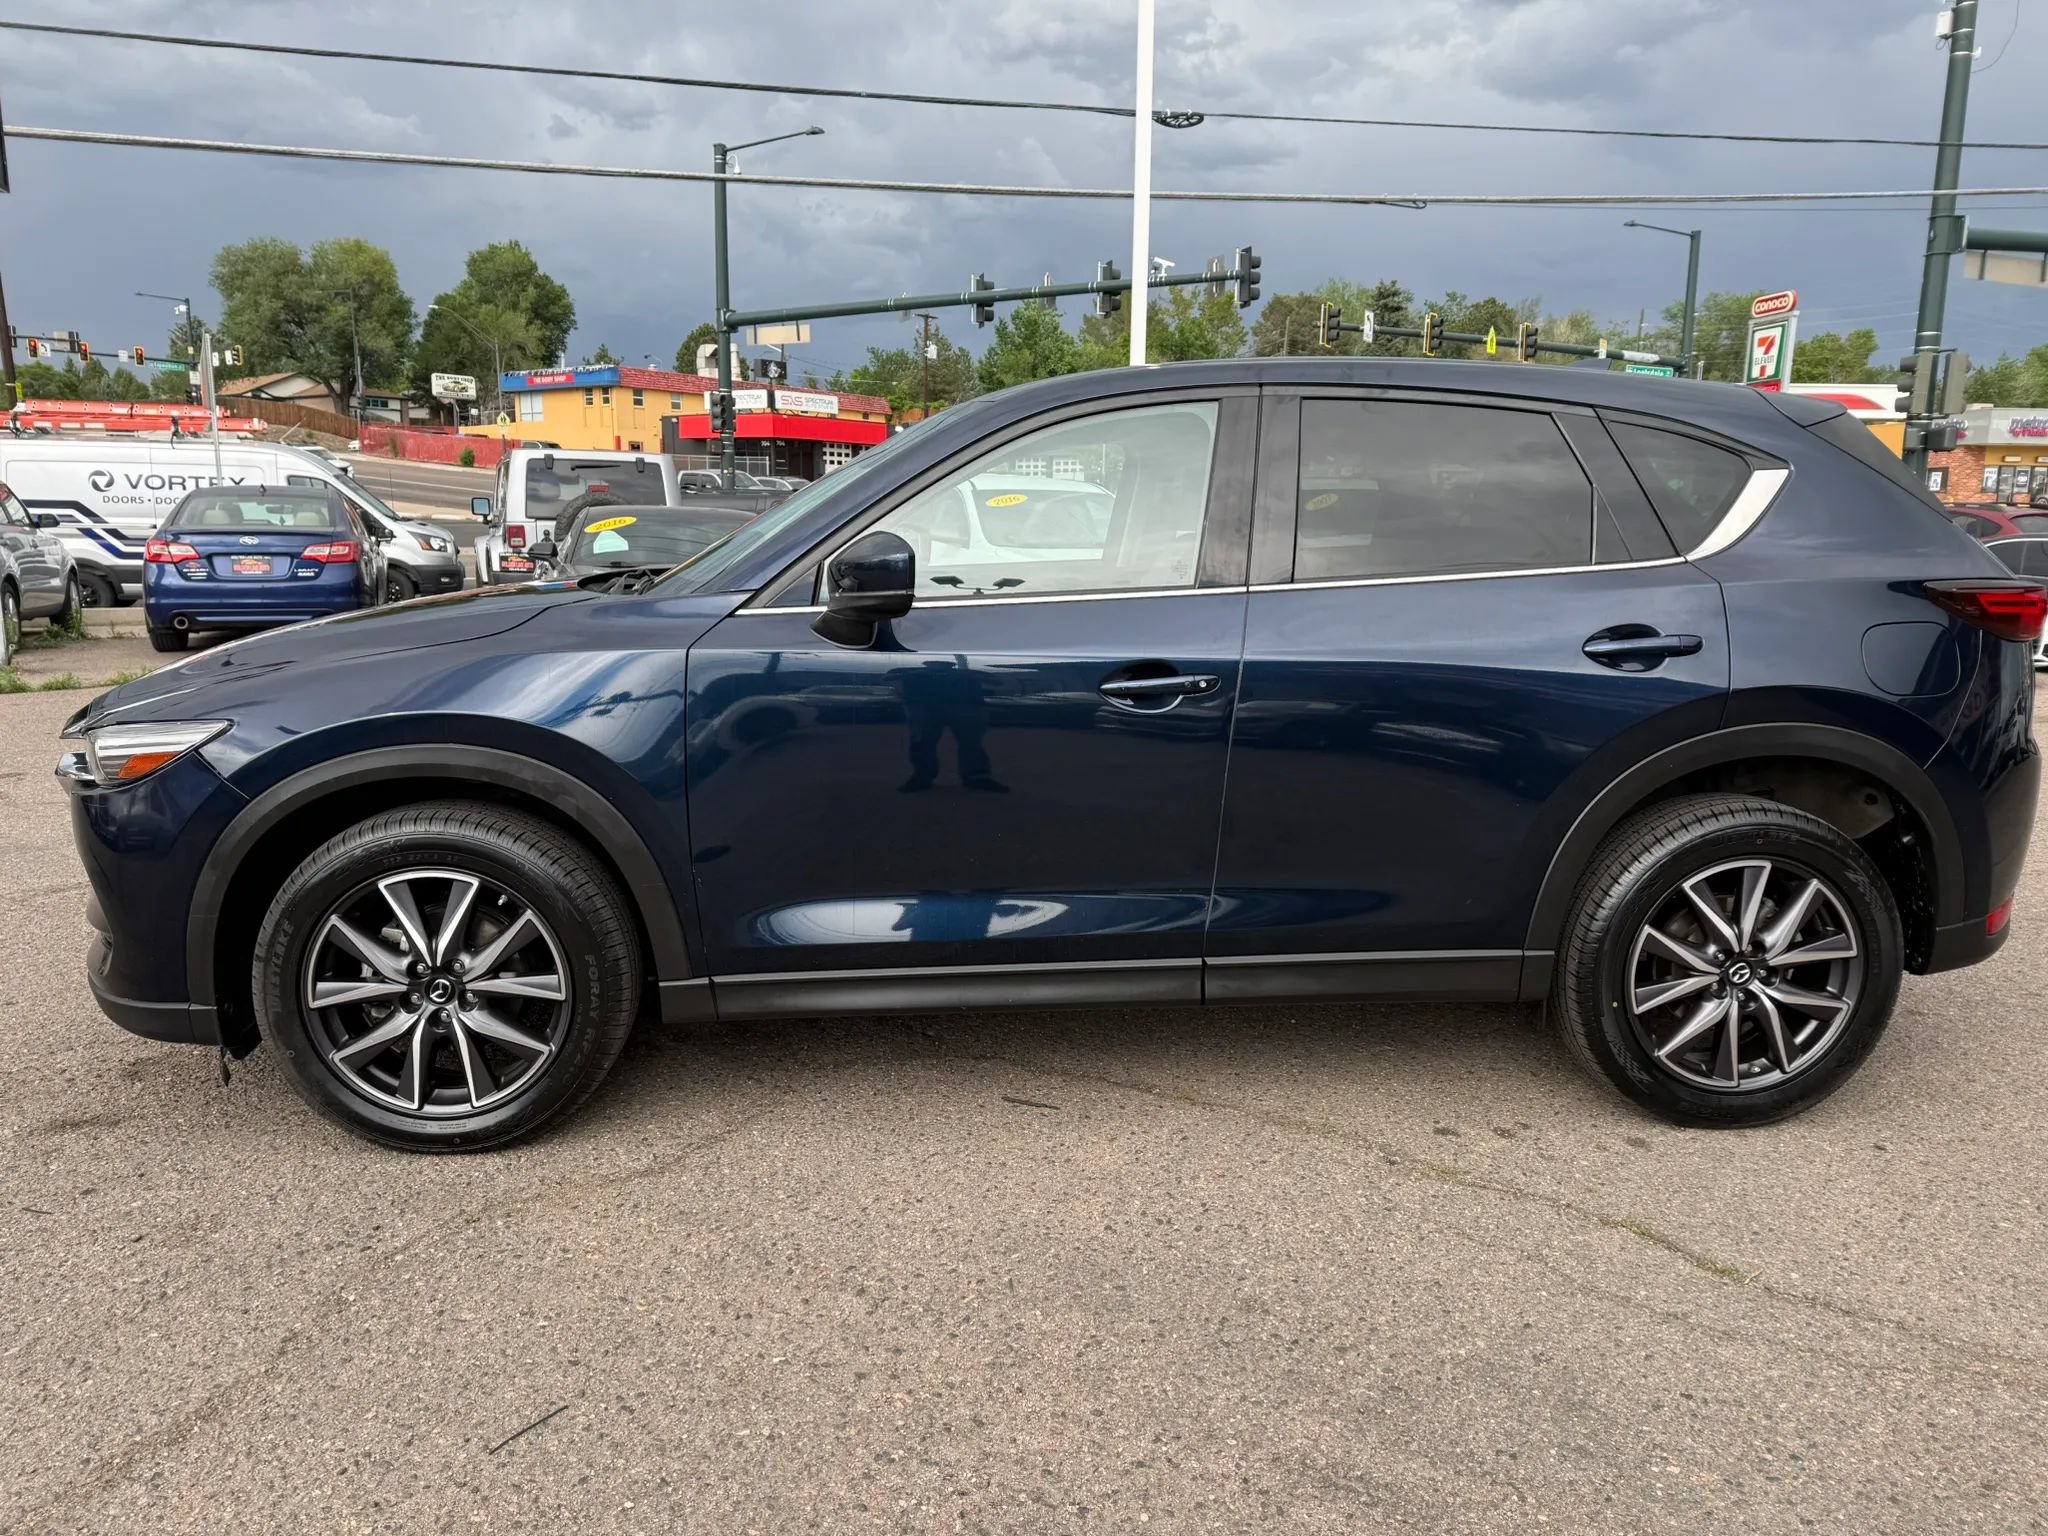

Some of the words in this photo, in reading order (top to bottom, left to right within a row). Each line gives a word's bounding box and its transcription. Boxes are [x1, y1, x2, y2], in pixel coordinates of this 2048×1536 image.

[804, 397, 834, 406] SPECTRUM
[102, 495, 144, 504] DOORS
[594, 519, 627, 530] 2016
